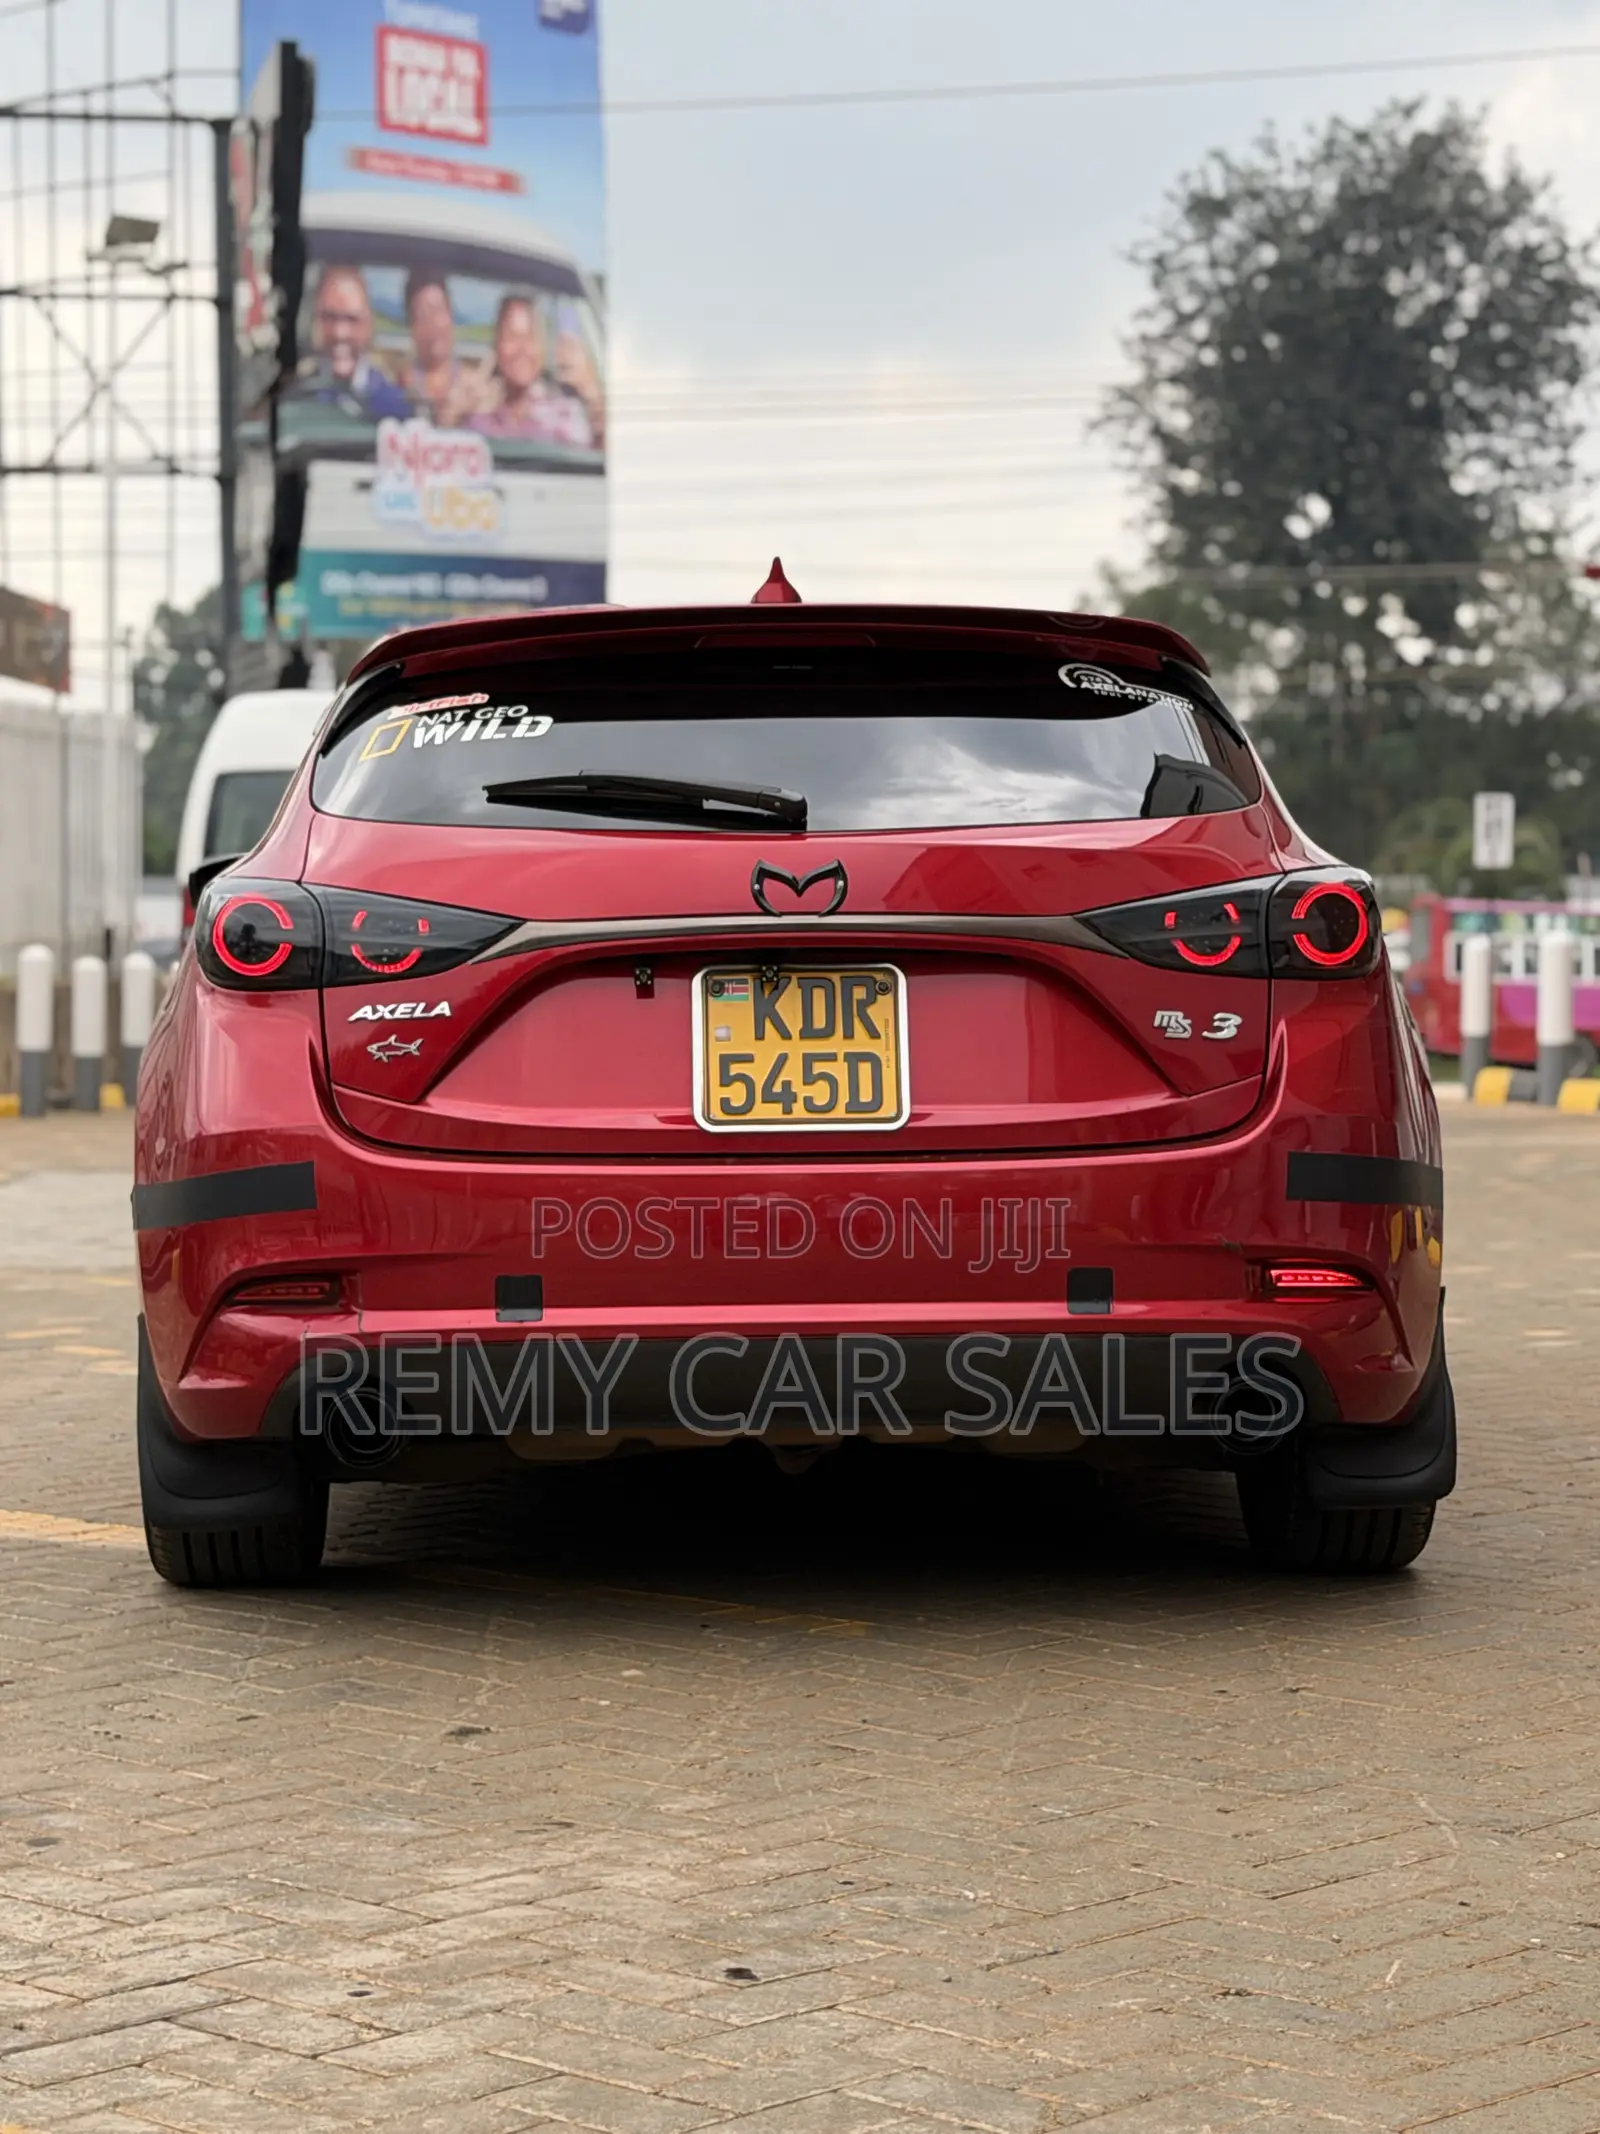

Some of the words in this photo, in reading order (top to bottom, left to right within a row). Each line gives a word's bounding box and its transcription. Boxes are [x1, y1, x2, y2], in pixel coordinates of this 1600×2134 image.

[417, 709, 470, 727] NAT
[474, 705, 528, 719] GEO
[413, 716, 553, 748] WILD
[347, 1001, 452, 1022] AXELA
[753, 976, 881, 1040] KDR
[1201, 1012, 1242, 1039] 3
[718, 1051, 884, 1116] 545D
